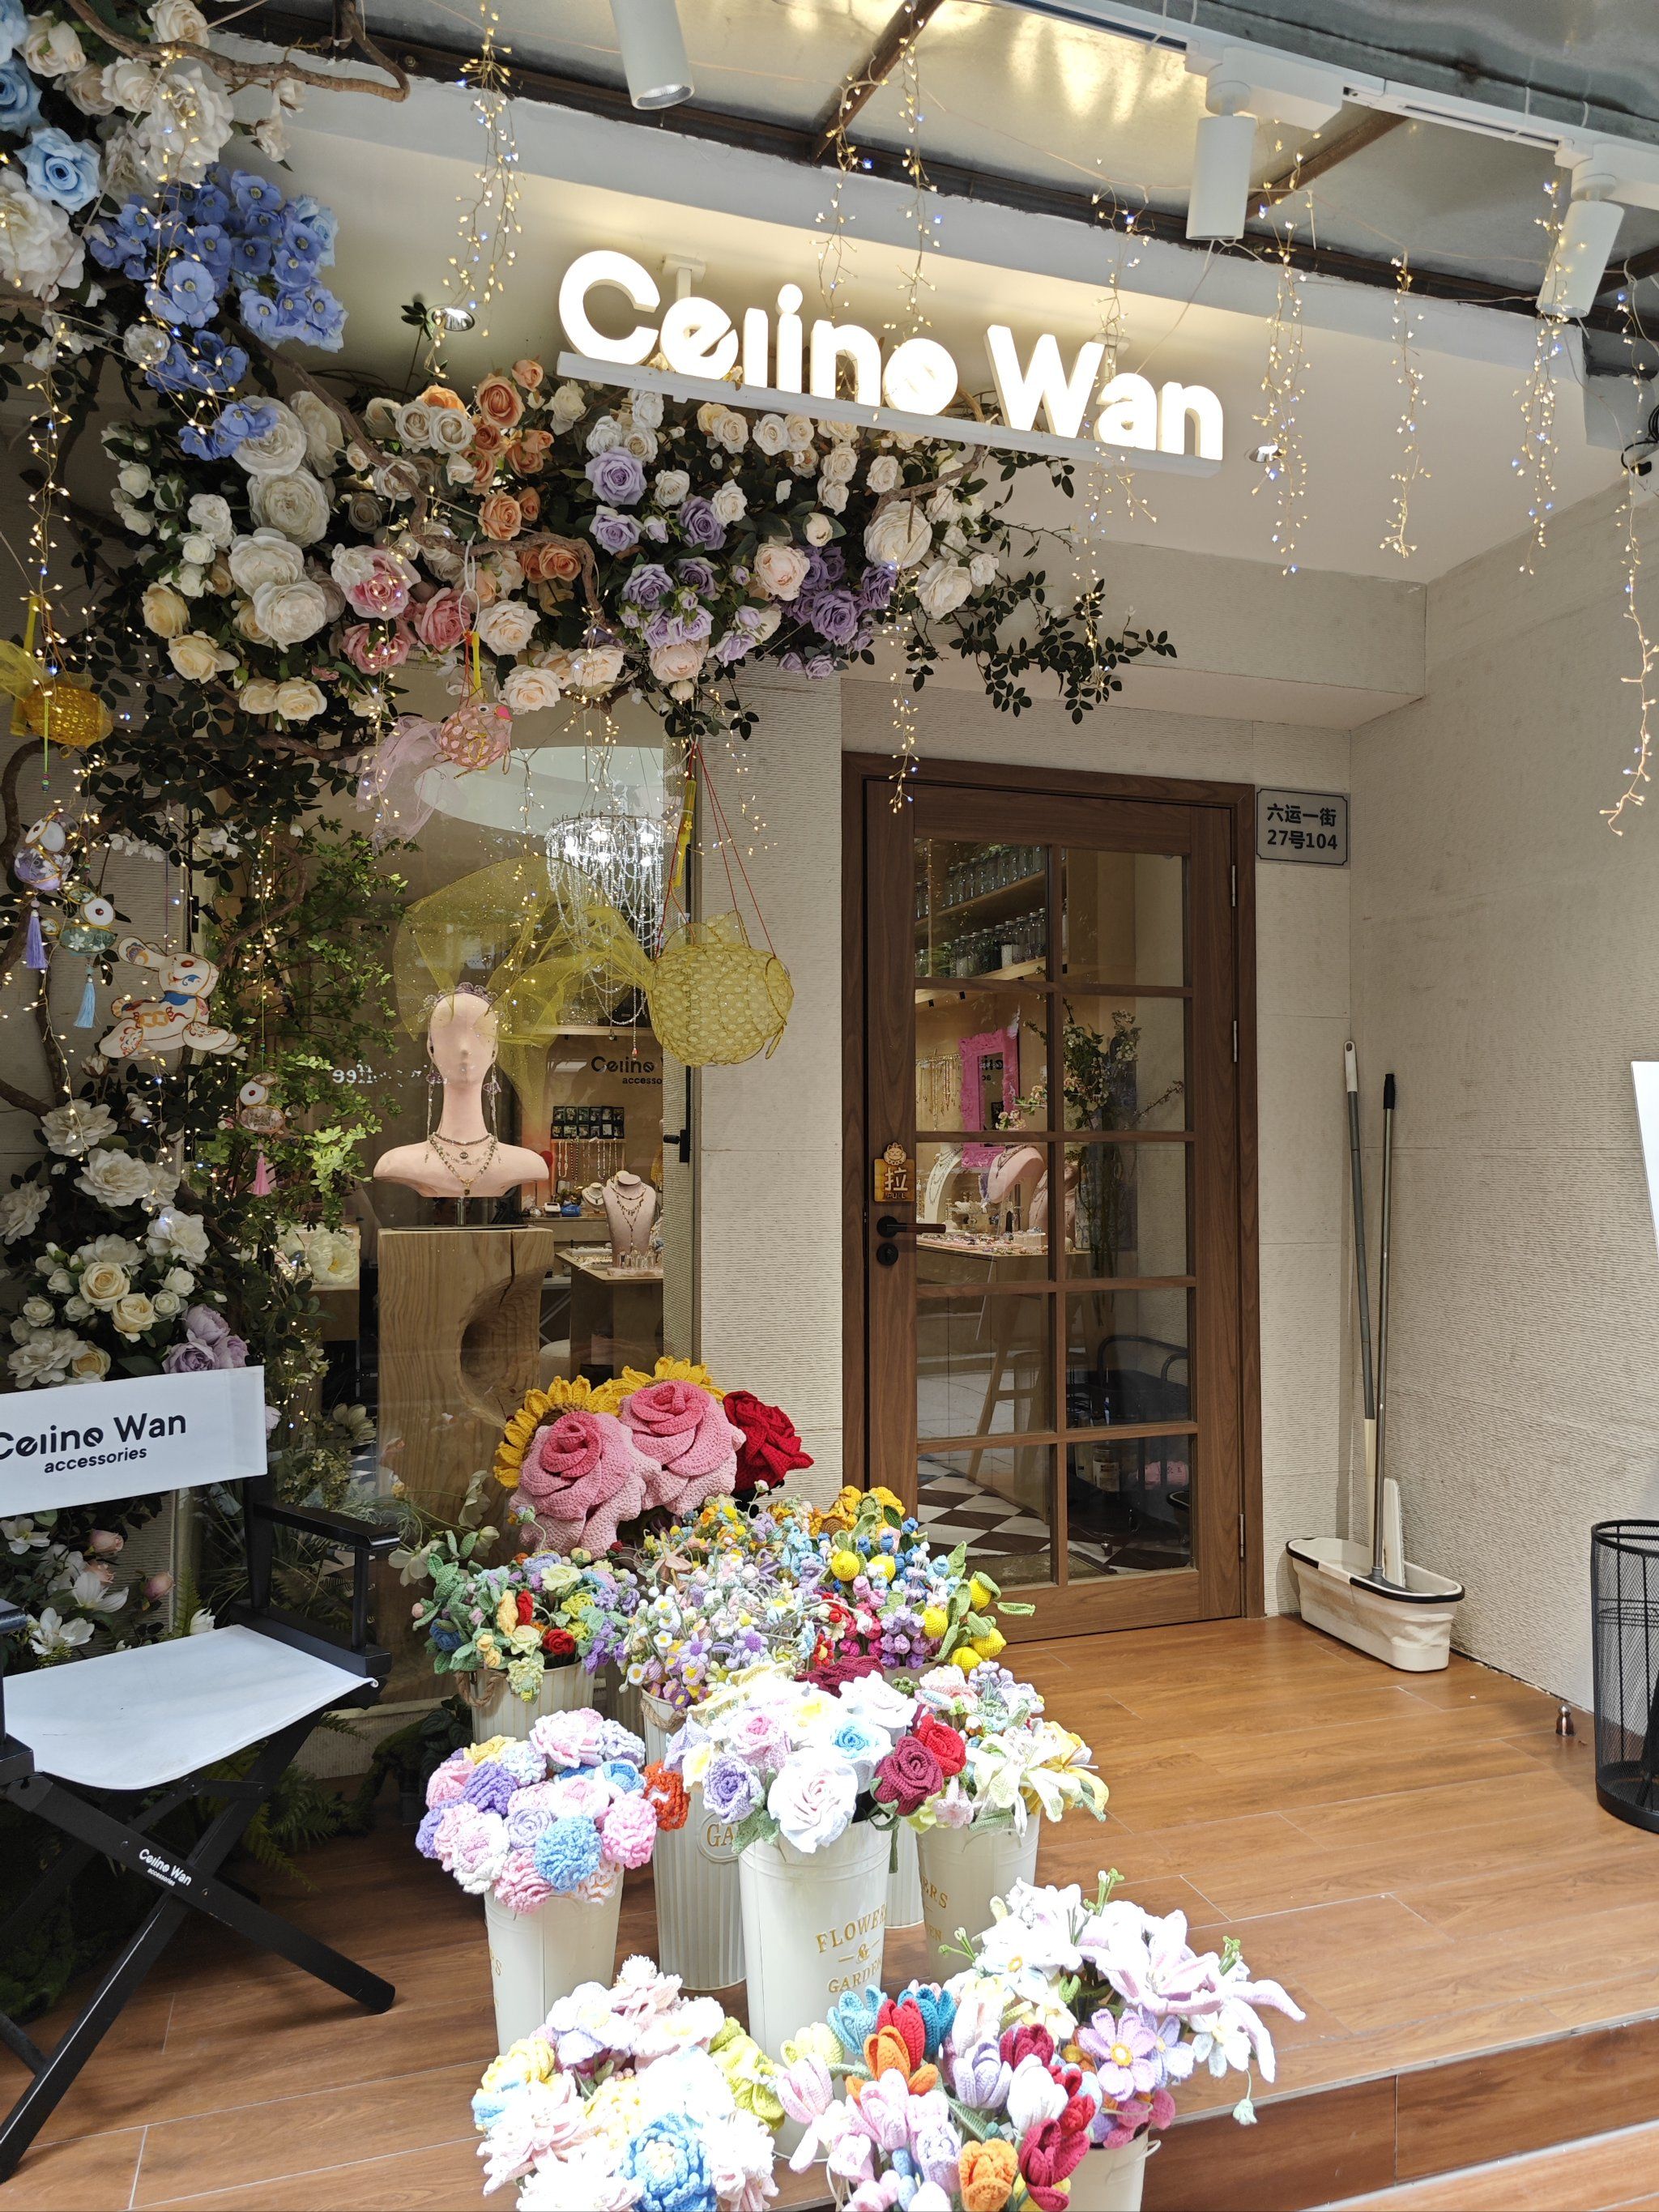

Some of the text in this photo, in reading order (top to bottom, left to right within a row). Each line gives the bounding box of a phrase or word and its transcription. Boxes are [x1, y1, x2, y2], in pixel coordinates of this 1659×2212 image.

[559, 249, 1224, 461] Celine Wan
[1267, 803, 1337, 827] 六运一街
[1267, 829, 1338, 850] 27号104
[591, 1055, 655, 1073] Celine
[884, 1166, 908, 1191] 拉
[113, 1412, 187, 1443] Wan
[44, 1447, 147, 1473] accessories
[139, 1848, 192, 1886] Celine Wan
[147, 1868, 176, 1886] accessories
